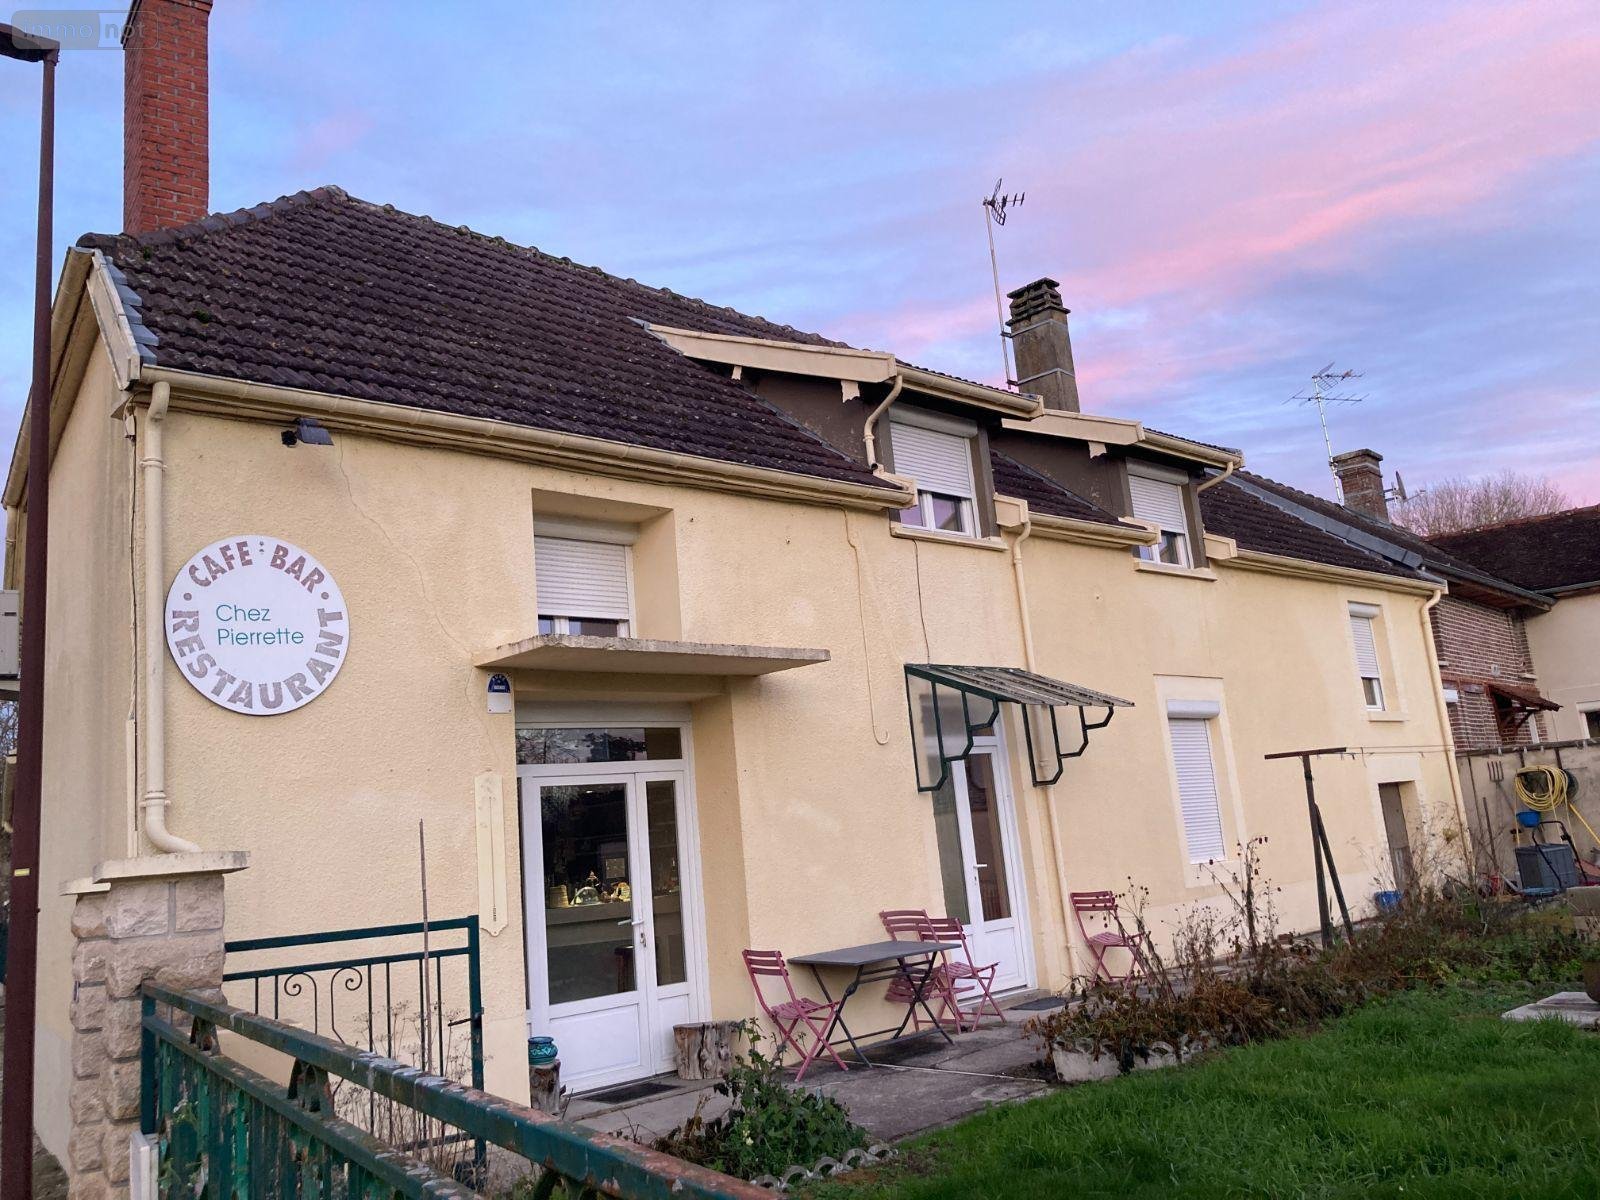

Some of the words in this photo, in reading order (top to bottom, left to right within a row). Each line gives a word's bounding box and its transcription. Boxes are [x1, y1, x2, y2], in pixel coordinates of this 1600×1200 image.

[269, 543, 325, 593] BAR
[215, 604, 271, 622] Chez
[217, 628, 304, 646] Pierrette
[172, 608, 344, 709] RESTAURANT
